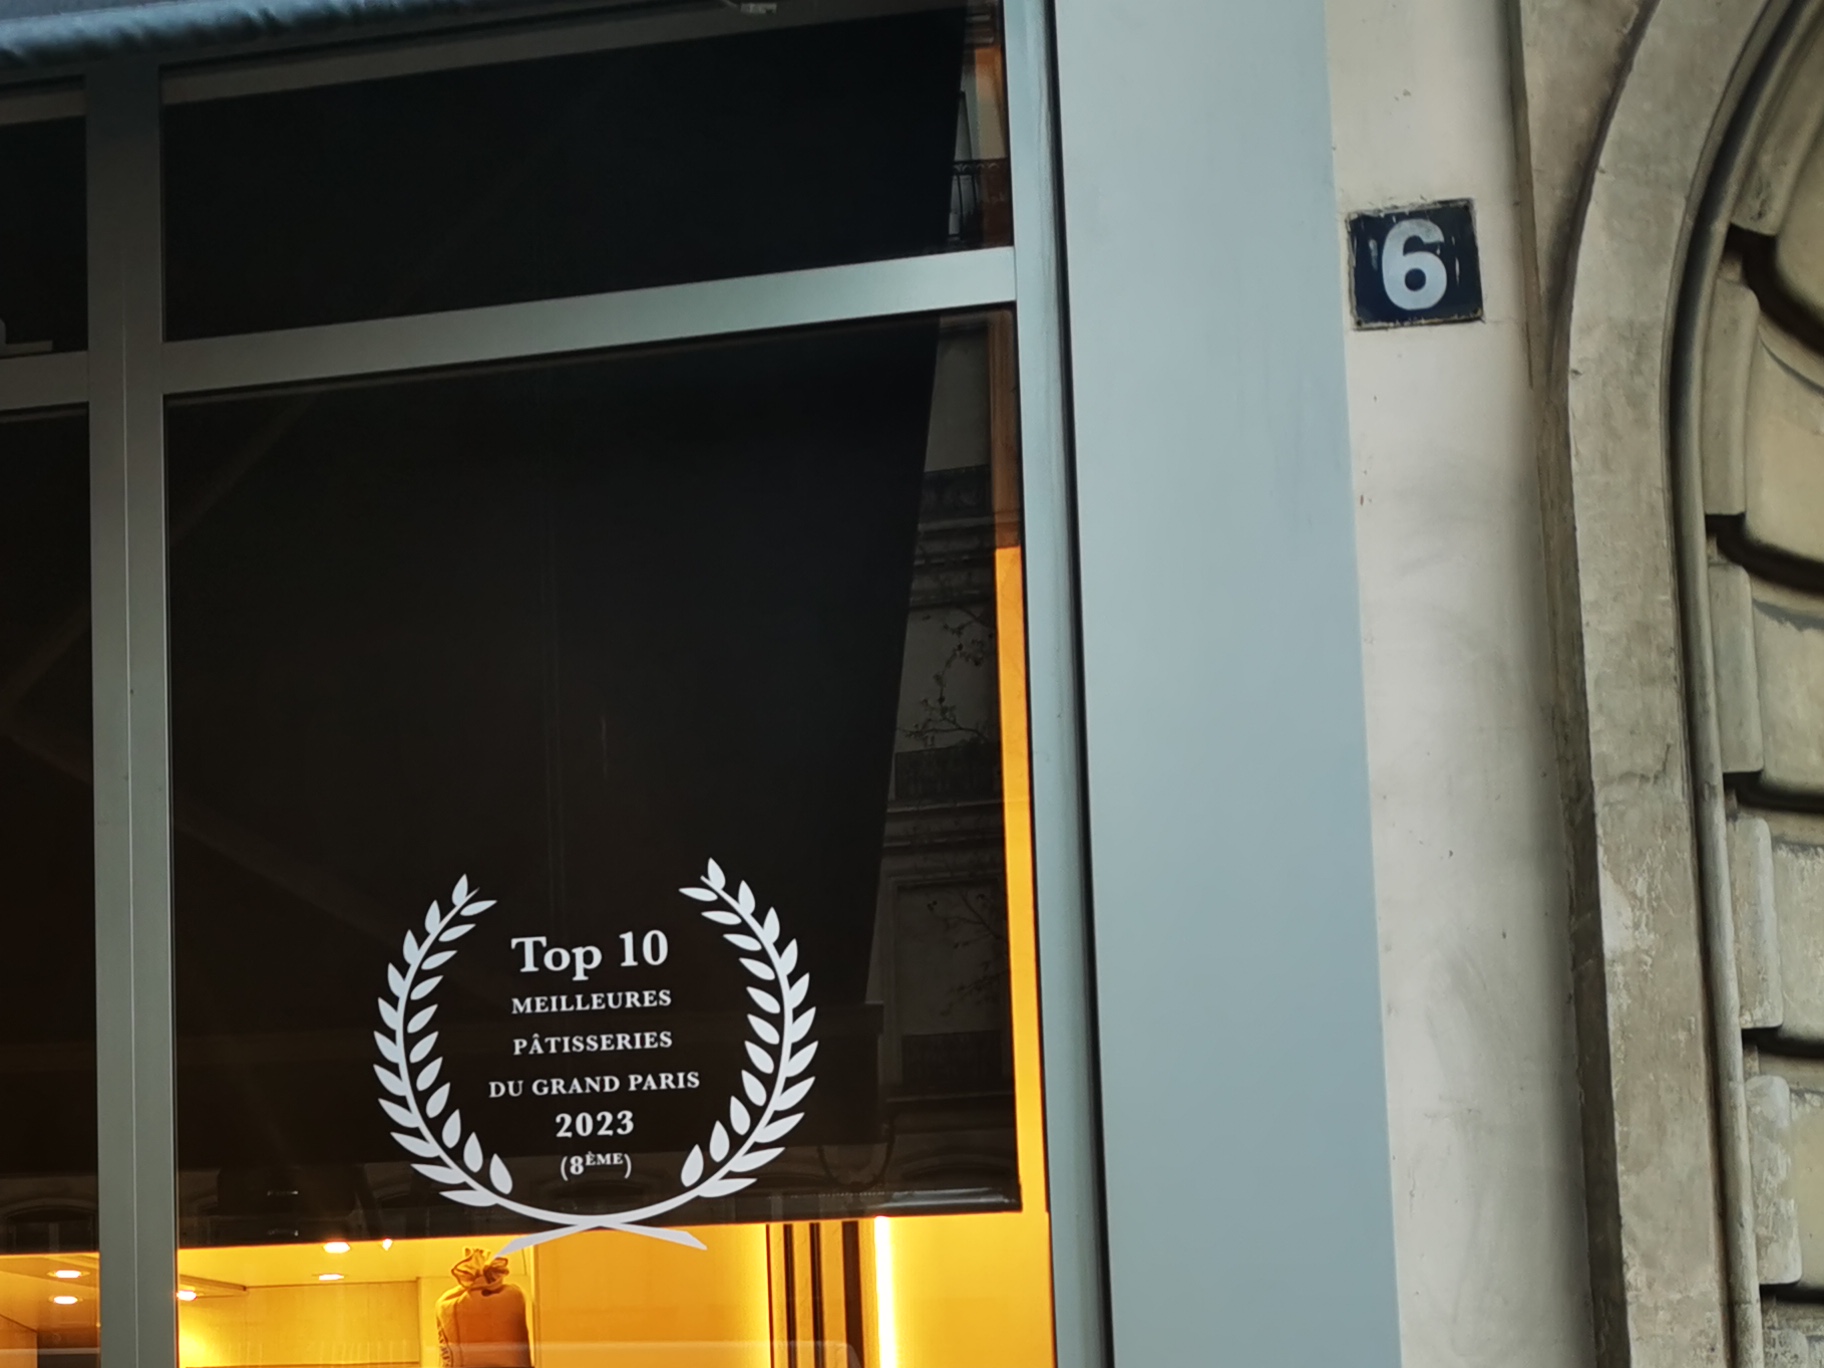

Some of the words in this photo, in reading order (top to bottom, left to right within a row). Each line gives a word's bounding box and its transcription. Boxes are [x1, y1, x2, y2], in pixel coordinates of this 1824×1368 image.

[1382, 218, 1447, 311] 6
[511, 935, 602, 981] Top
[619, 929, 668, 967] 10
[511, 989, 672, 1014] MEILLEURES
[513, 1031, 673, 1055] PÂTISSERIES
[489, 1080, 523, 1098] DU
[532, 1075, 620, 1097] GRAND
[628, 1071, 700, 1091] PARIS
[555, 1110, 635, 1138] 2023
